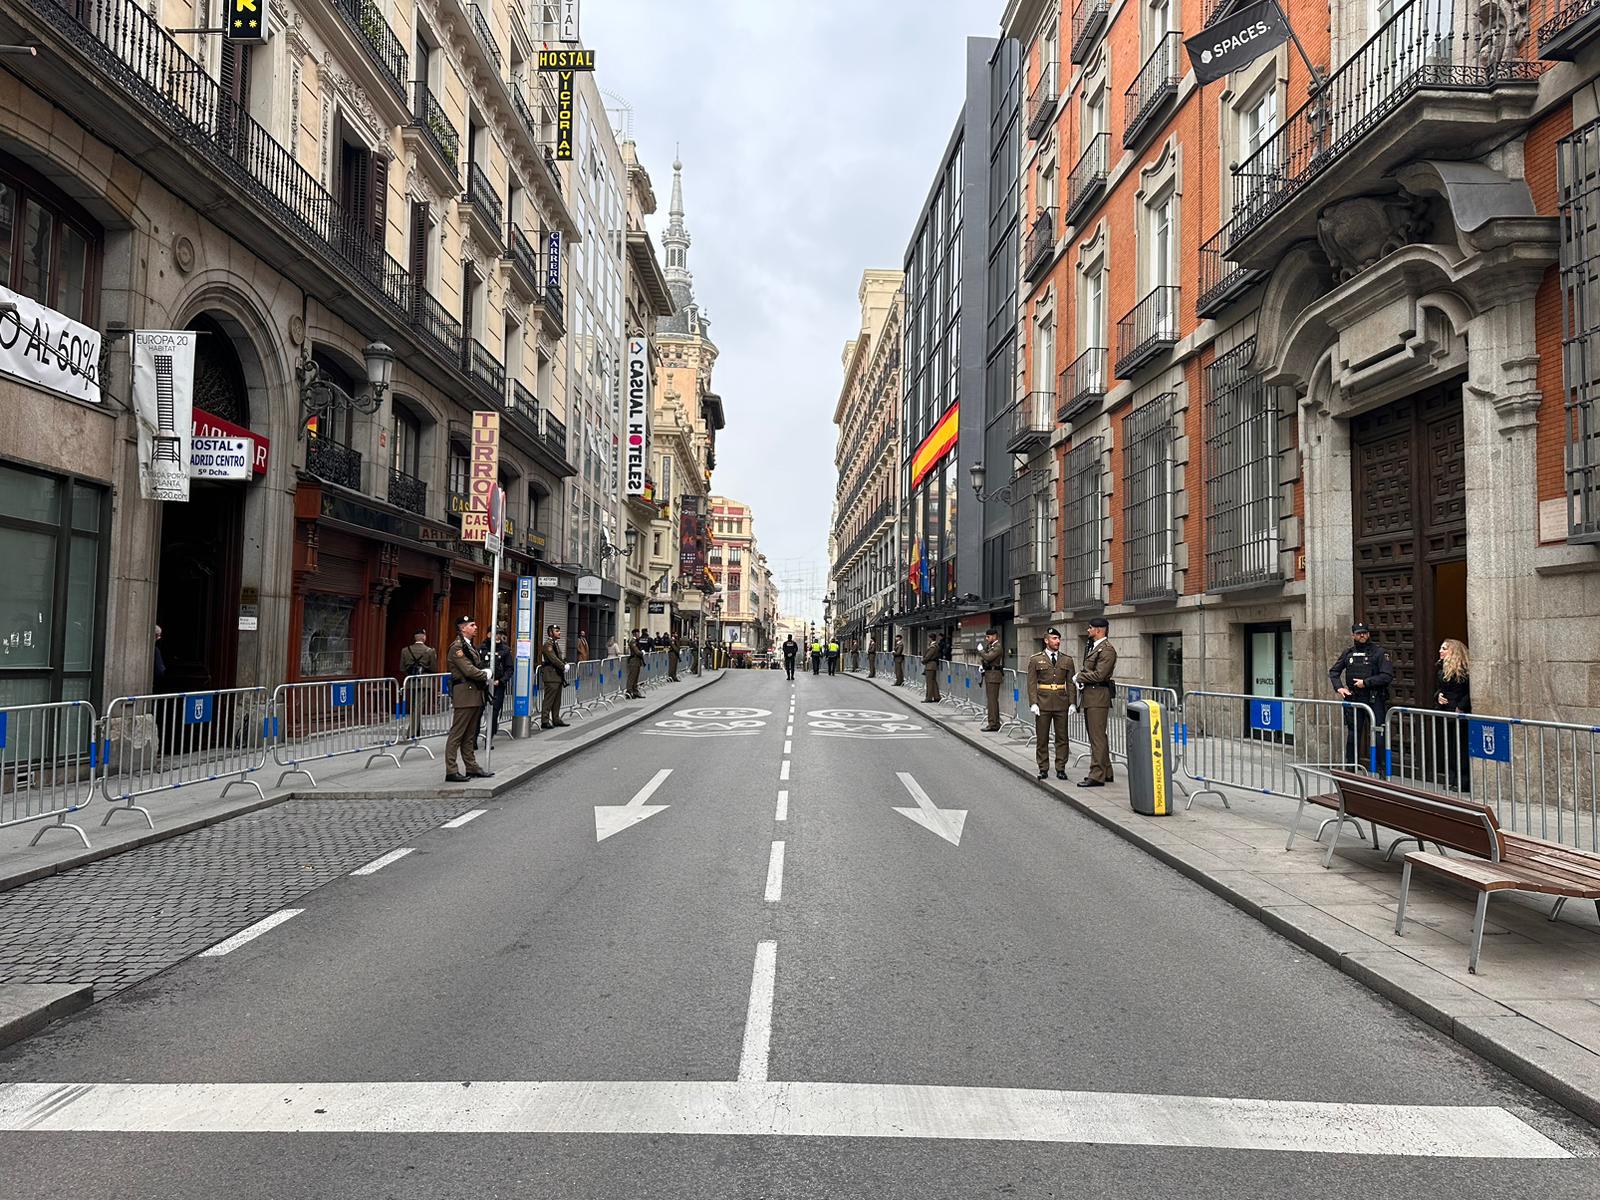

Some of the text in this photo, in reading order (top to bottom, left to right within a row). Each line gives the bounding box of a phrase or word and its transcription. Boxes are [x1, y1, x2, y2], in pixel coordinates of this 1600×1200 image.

[540, 52, 593, 67] HOSTAL
[559, 72, 572, 150] VICTORIA
[549, 231, 561, 286] CARRERA
[24, 317, 51, 366] AL
[57, 329, 96, 391] 50%
[136, 334, 189, 346] EUROPA 20
[627, 359, 645, 491] CASUAL HOTELES
[191, 454, 214, 466] ADRID
[215, 455, 245, 467] CENTRO
[208, 468, 230, 476] Dcha.
[472, 413, 496, 512] TURRON
